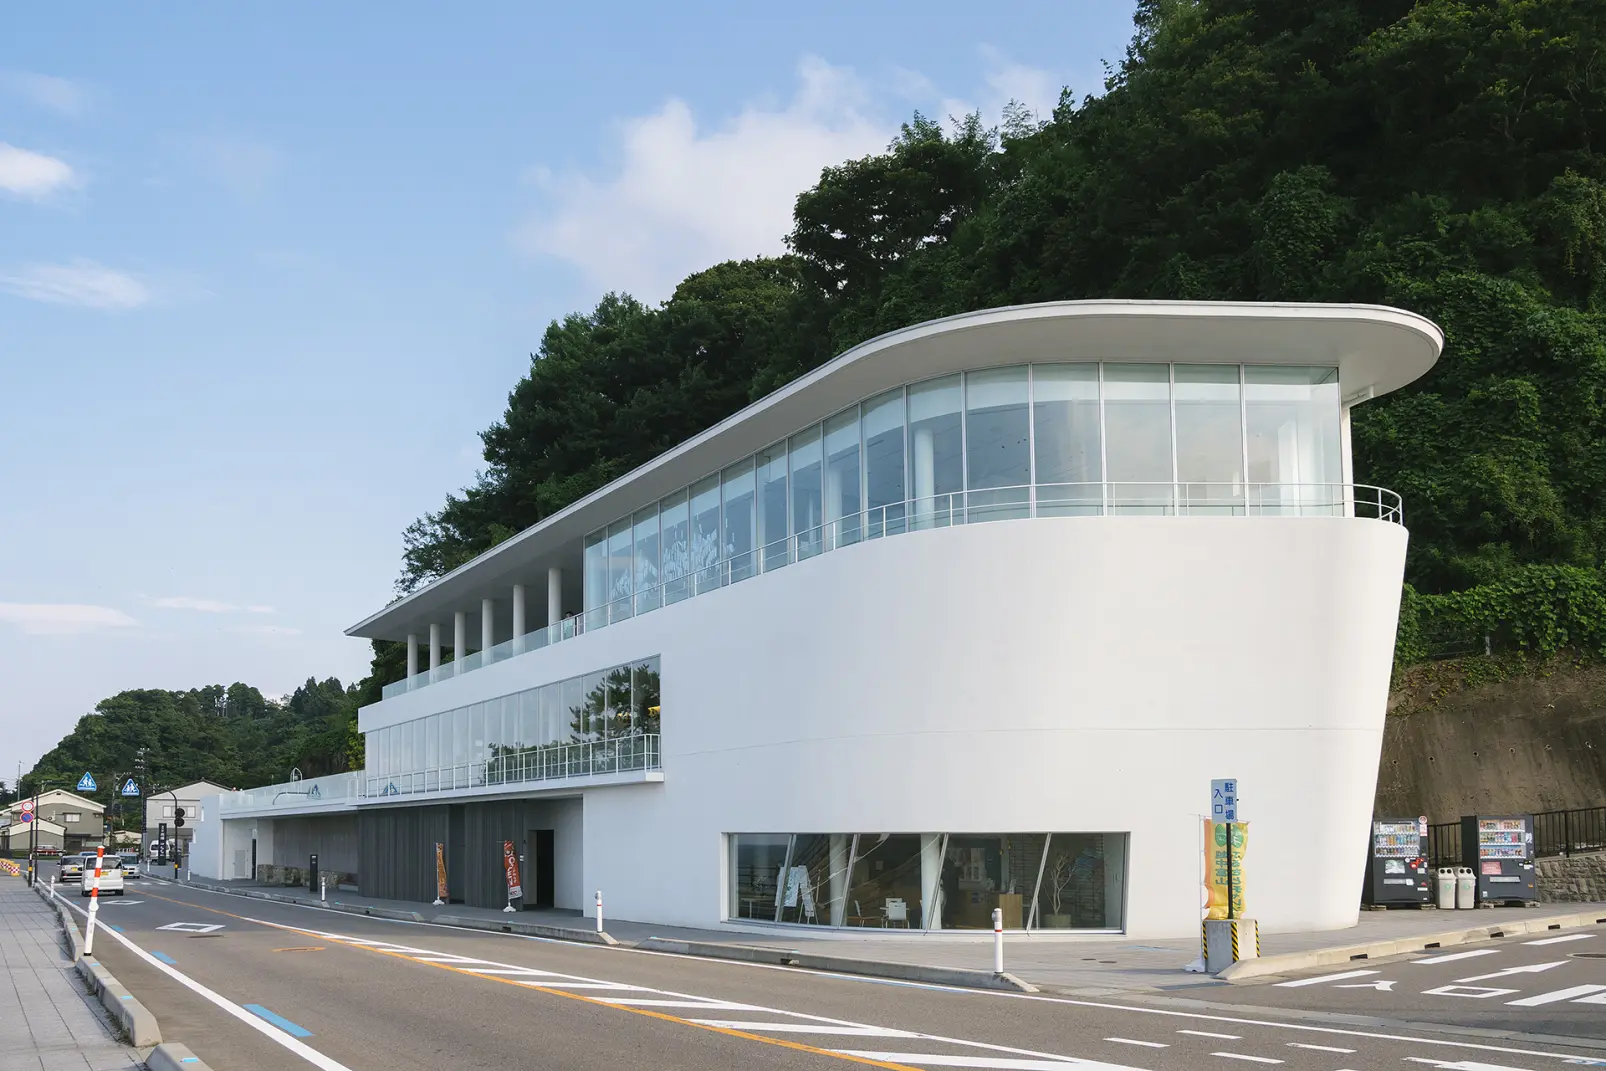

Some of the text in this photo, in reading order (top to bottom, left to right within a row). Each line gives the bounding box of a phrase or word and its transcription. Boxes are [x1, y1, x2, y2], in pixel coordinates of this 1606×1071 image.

[1214, 789, 1223, 814] 入口
[1224, 782, 1235, 820] 駐車場
